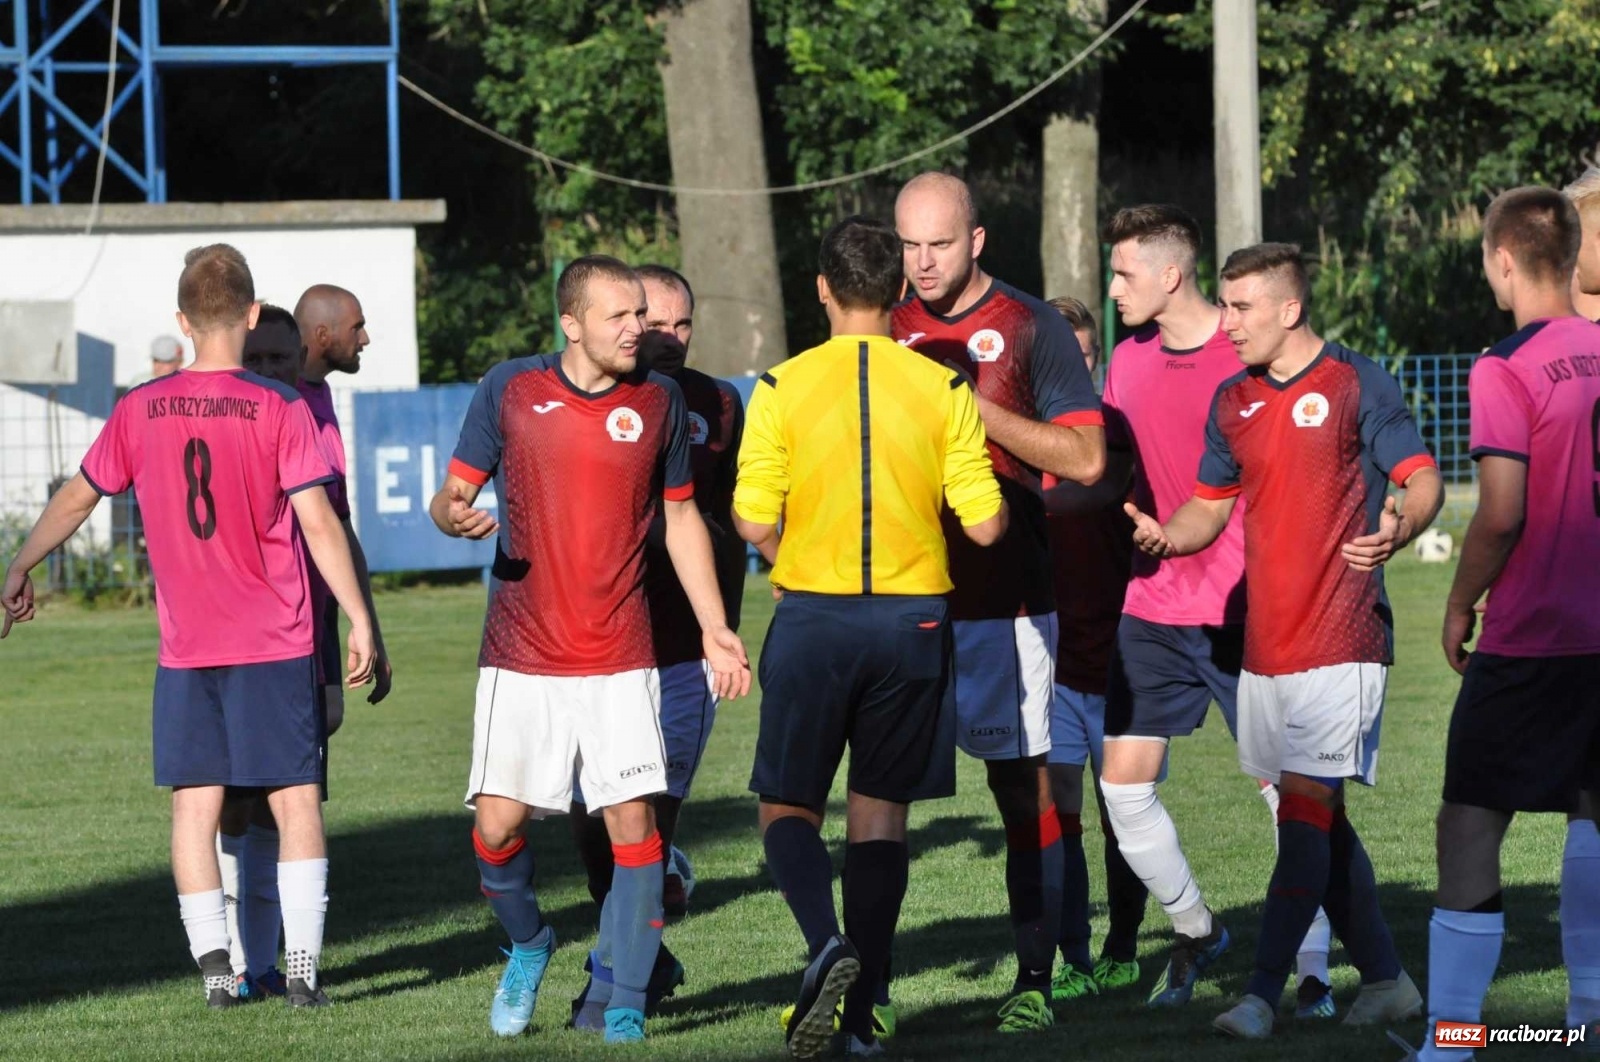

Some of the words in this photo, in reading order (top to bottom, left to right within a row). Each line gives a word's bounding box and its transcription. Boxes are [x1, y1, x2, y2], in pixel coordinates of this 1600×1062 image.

[147, 396, 167, 420] LKS
[169, 394, 260, 421] KRZYŻANOWICE
[183, 436, 217, 541] 8
[1318, 752, 1345, 762] JAKO
